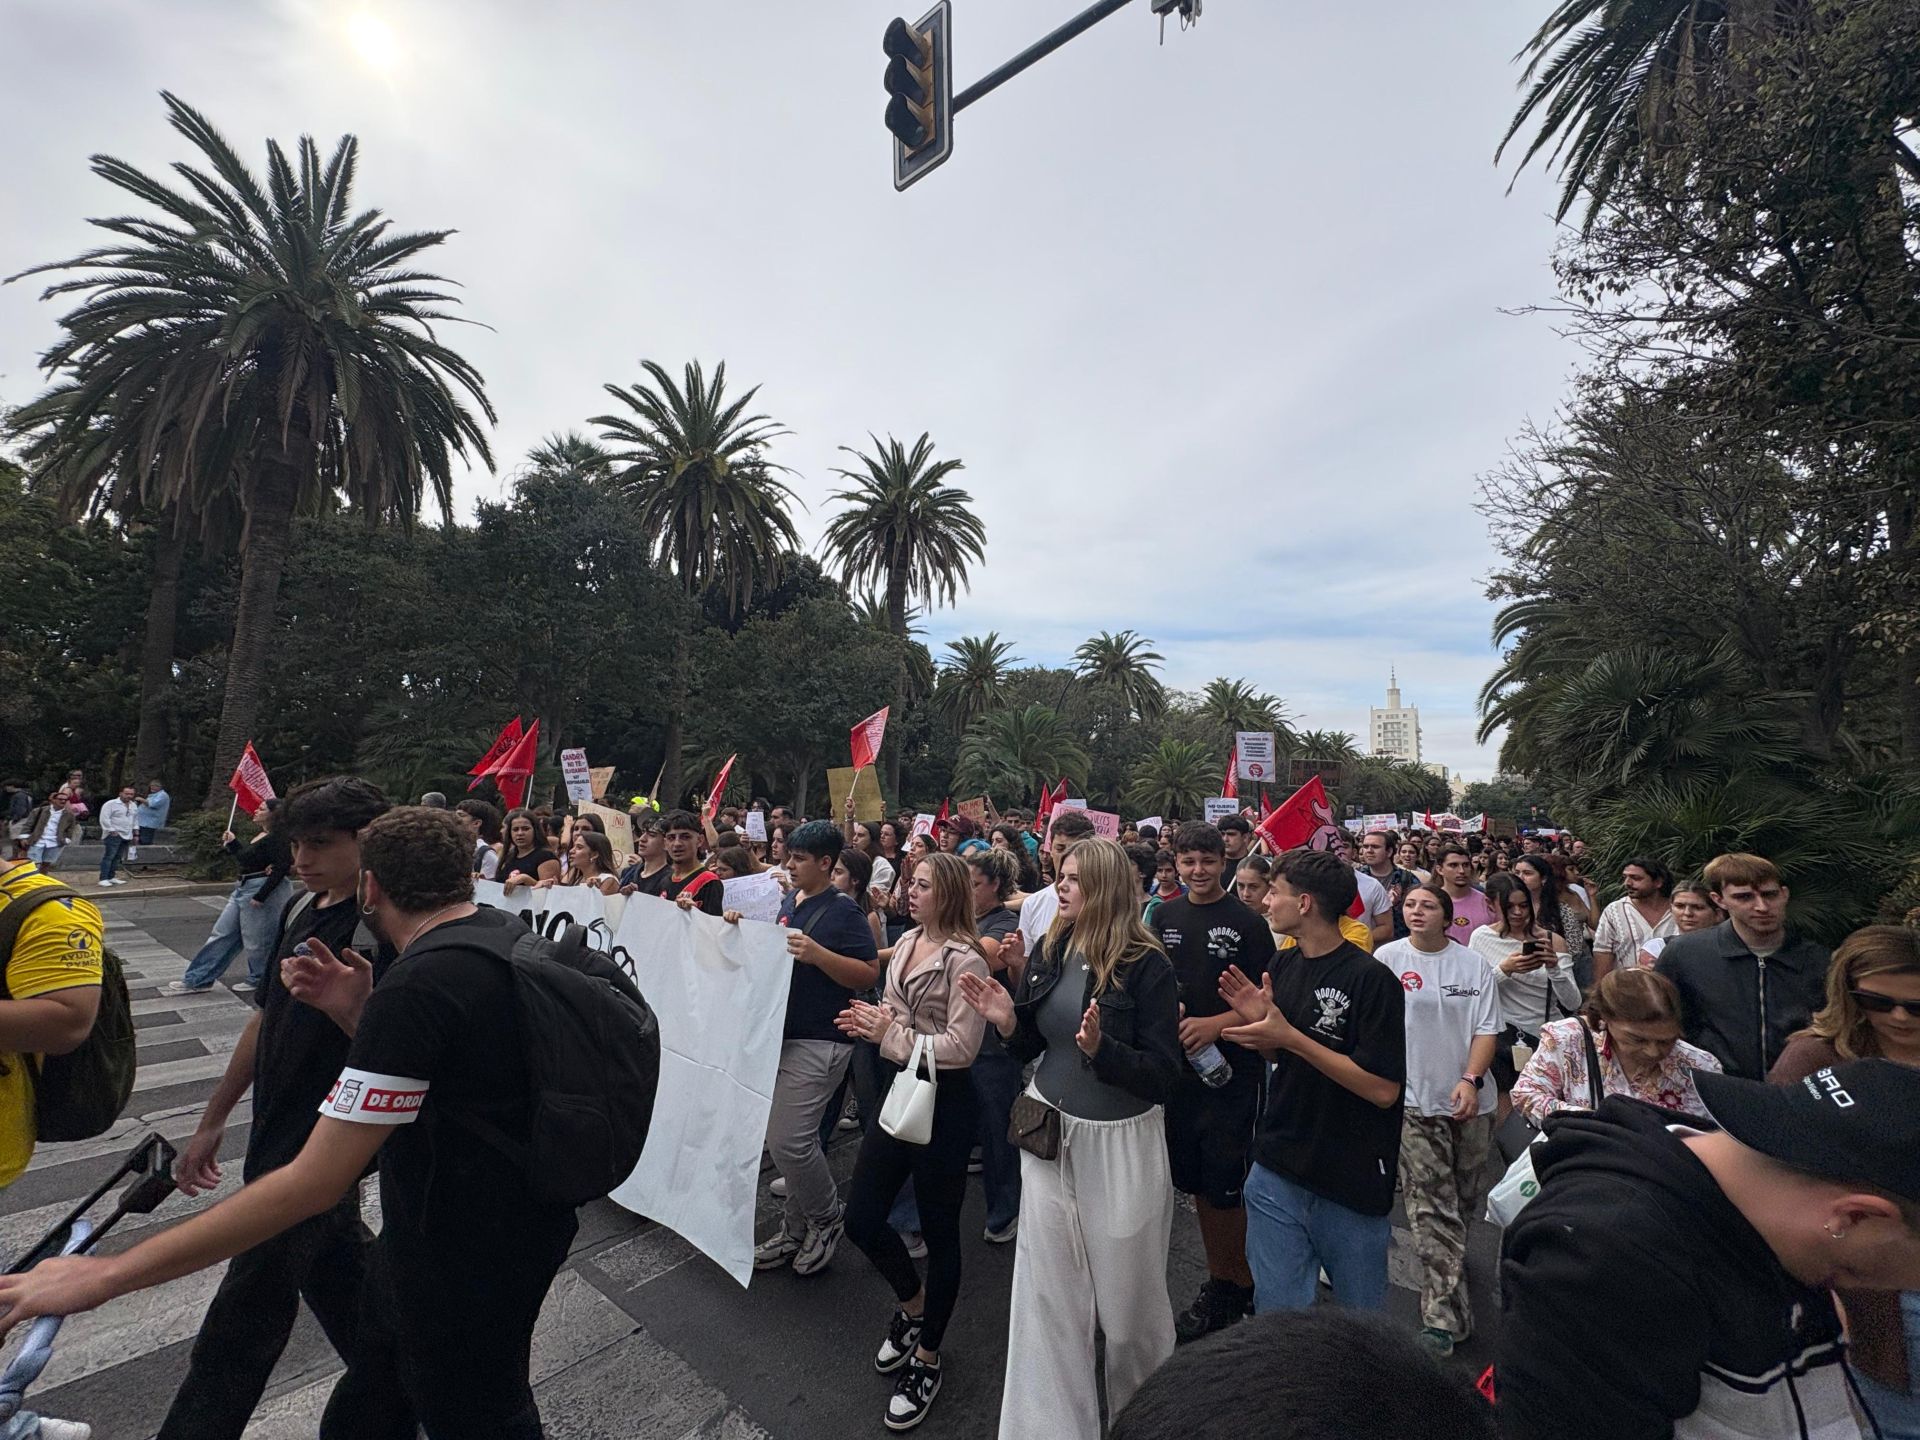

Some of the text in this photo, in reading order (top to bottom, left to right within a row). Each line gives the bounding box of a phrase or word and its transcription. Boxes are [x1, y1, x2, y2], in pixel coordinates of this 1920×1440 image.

[1207, 926, 1242, 943] HOODRICH
[1314, 987, 1351, 1010] HOODRICH
[367, 1093, 390, 1107] DE
